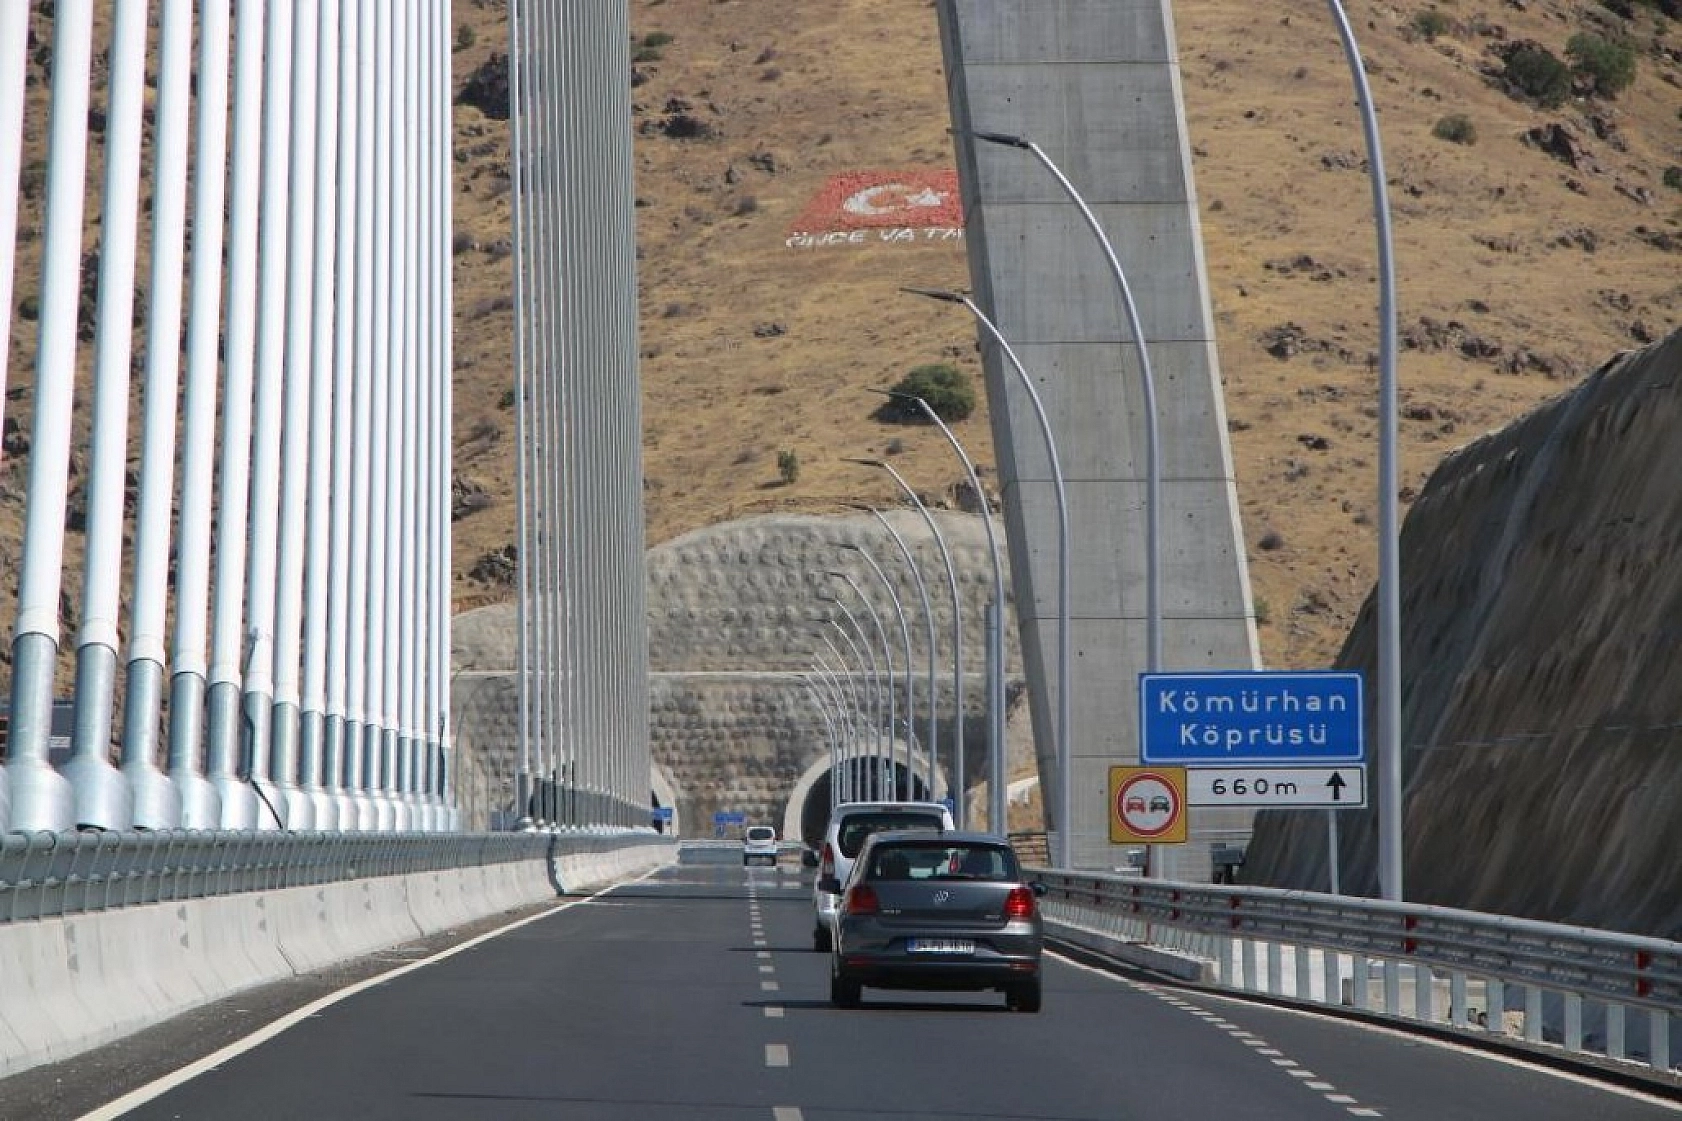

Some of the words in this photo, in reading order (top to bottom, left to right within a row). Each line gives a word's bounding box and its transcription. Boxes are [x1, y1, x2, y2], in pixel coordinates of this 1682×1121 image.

[1159, 689, 1346, 713] Kömürhan
[1180, 723, 1327, 751] Köprüsü
[1212, 778, 1297, 795] 660m
